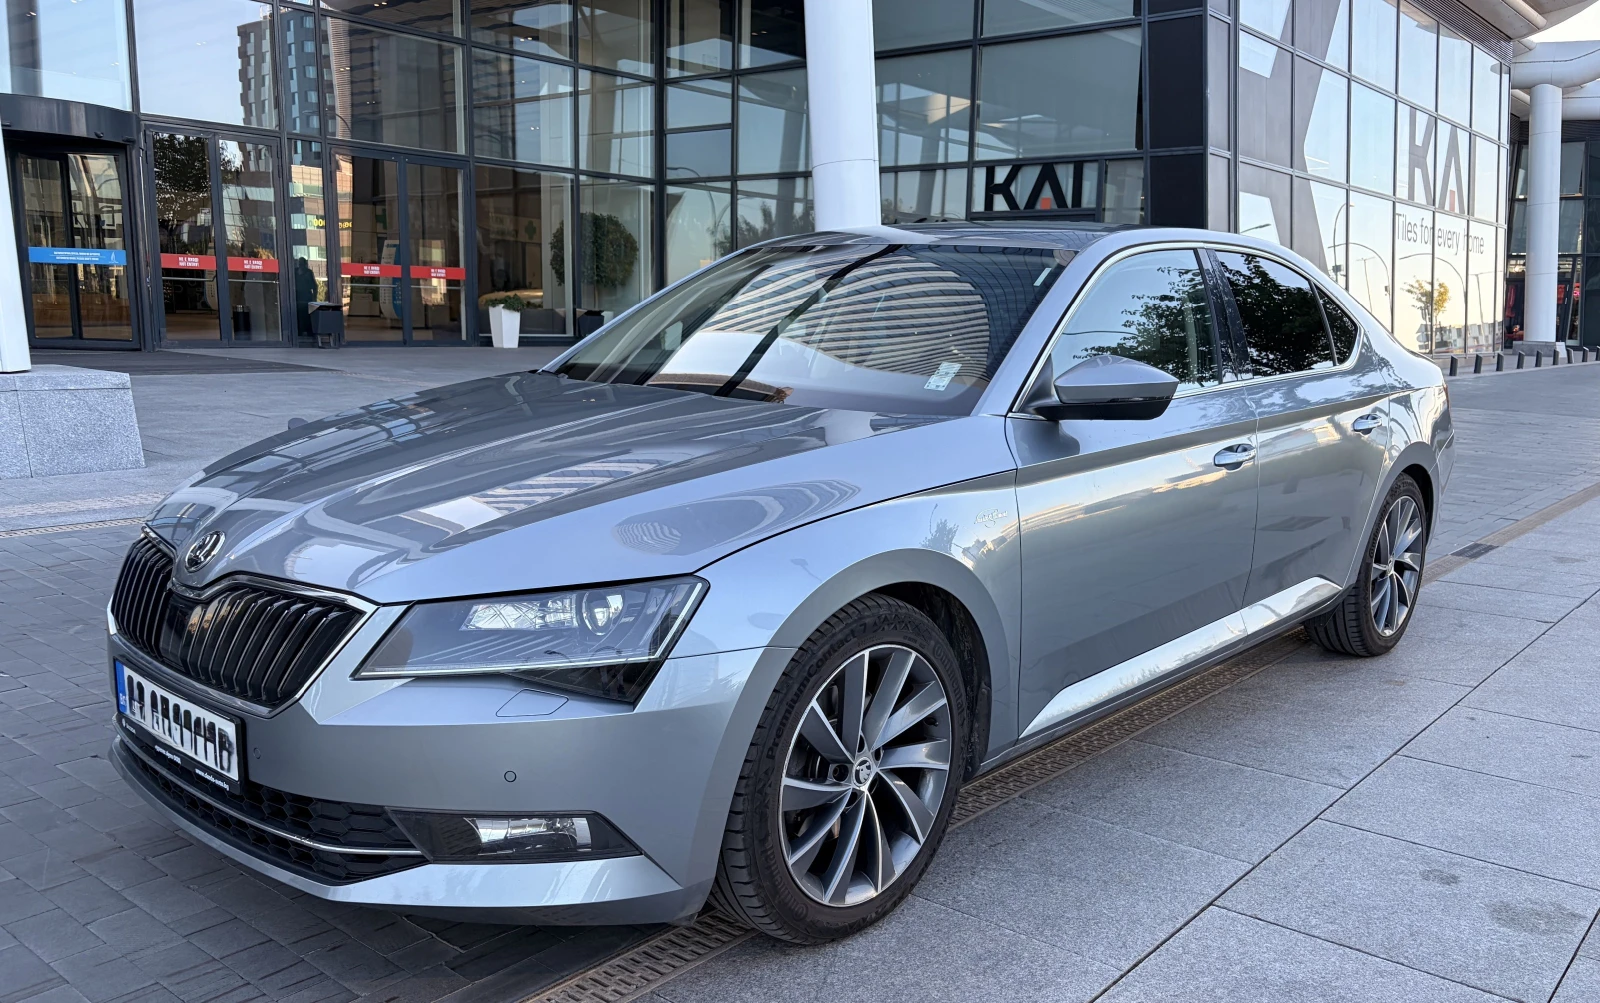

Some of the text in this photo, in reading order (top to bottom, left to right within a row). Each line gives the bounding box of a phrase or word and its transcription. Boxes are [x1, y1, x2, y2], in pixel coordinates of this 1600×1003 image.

[984, 161, 1084, 212] KAI
[1407, 106, 1476, 217] KAI
[1396, 213, 1418, 242] Tiles
[1420, 218, 1434, 246] for
[1437, 228, 1461, 255] every
[766, 628, 857, 760] PremiumContact
[934, 643, 966, 716] Continental
